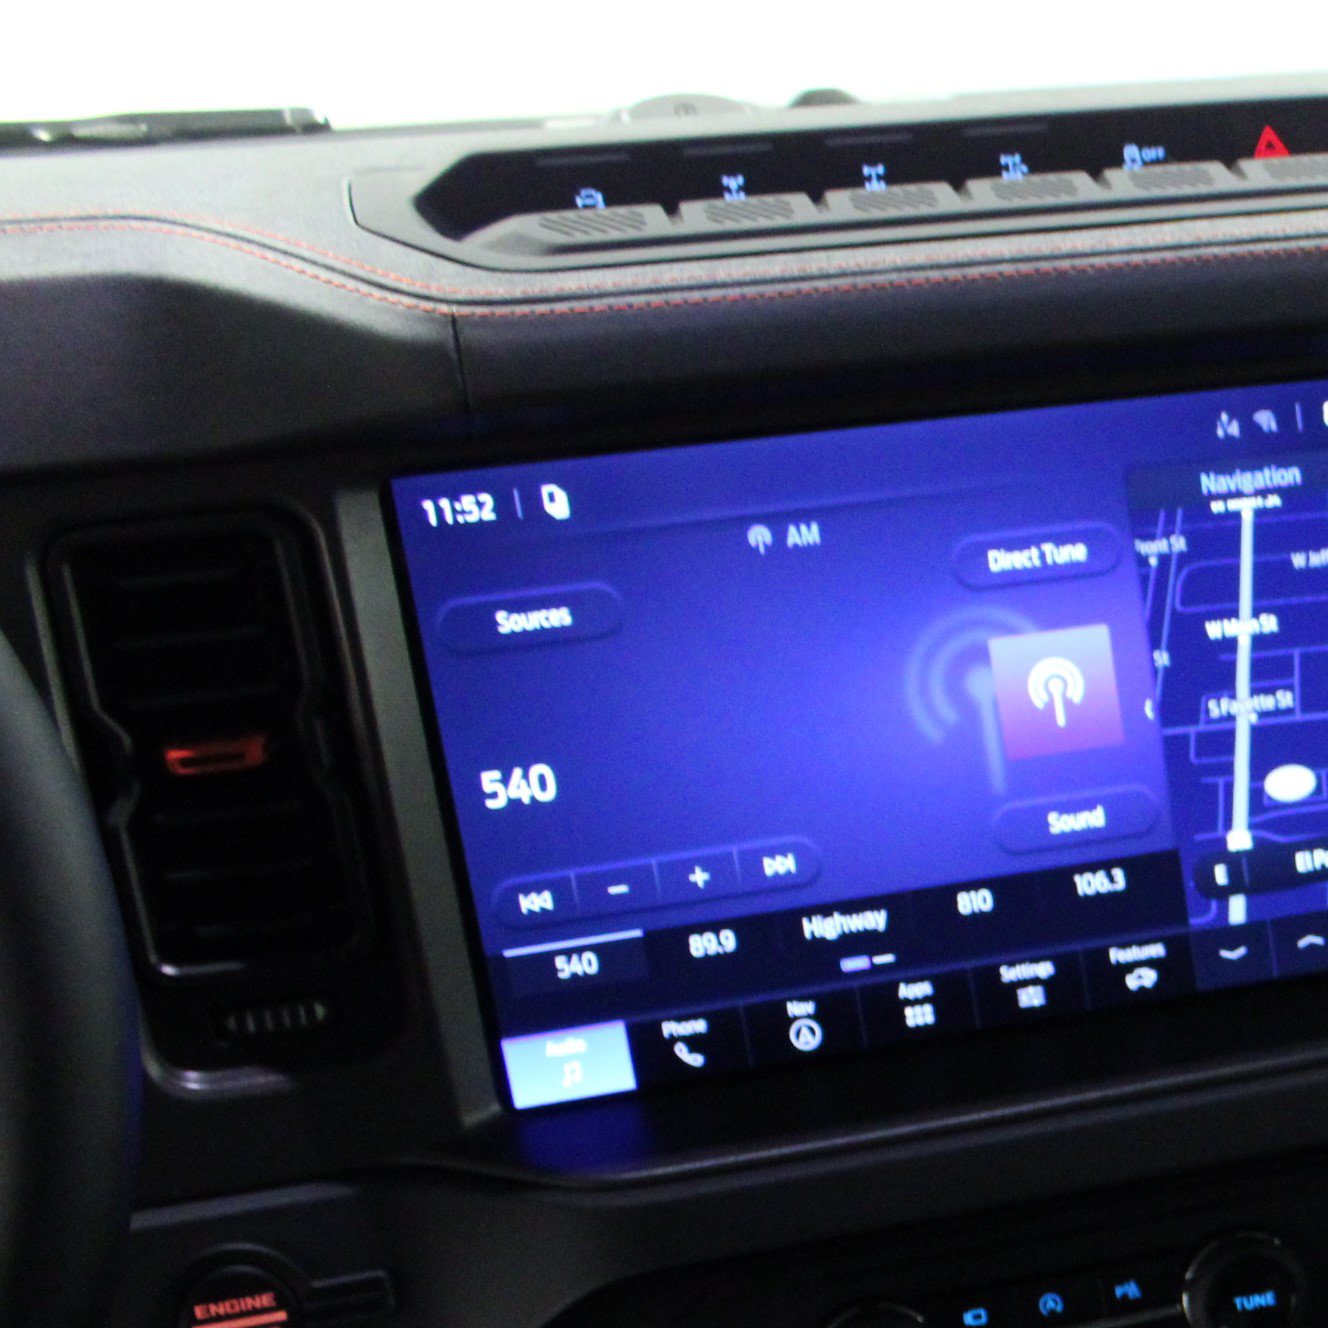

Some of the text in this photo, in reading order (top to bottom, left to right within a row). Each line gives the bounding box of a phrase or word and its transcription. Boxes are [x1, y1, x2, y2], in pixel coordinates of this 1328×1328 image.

[1200, 465, 1302, 496] Navigation
[420, 491, 497, 528] 11:52
[786, 521, 821, 549] AM
[986, 539, 1088, 574] Direct Tune
[494, 605, 573, 635] Sources
[479, 763, 558, 810] 540
[1046, 805, 1106, 835] Sound
[801, 907, 888, 941] Highway
[554, 950, 600, 980] 540
[194, 1291, 277, 1320] ENGINE
[1233, 1289, 1277, 1312] TUNE
